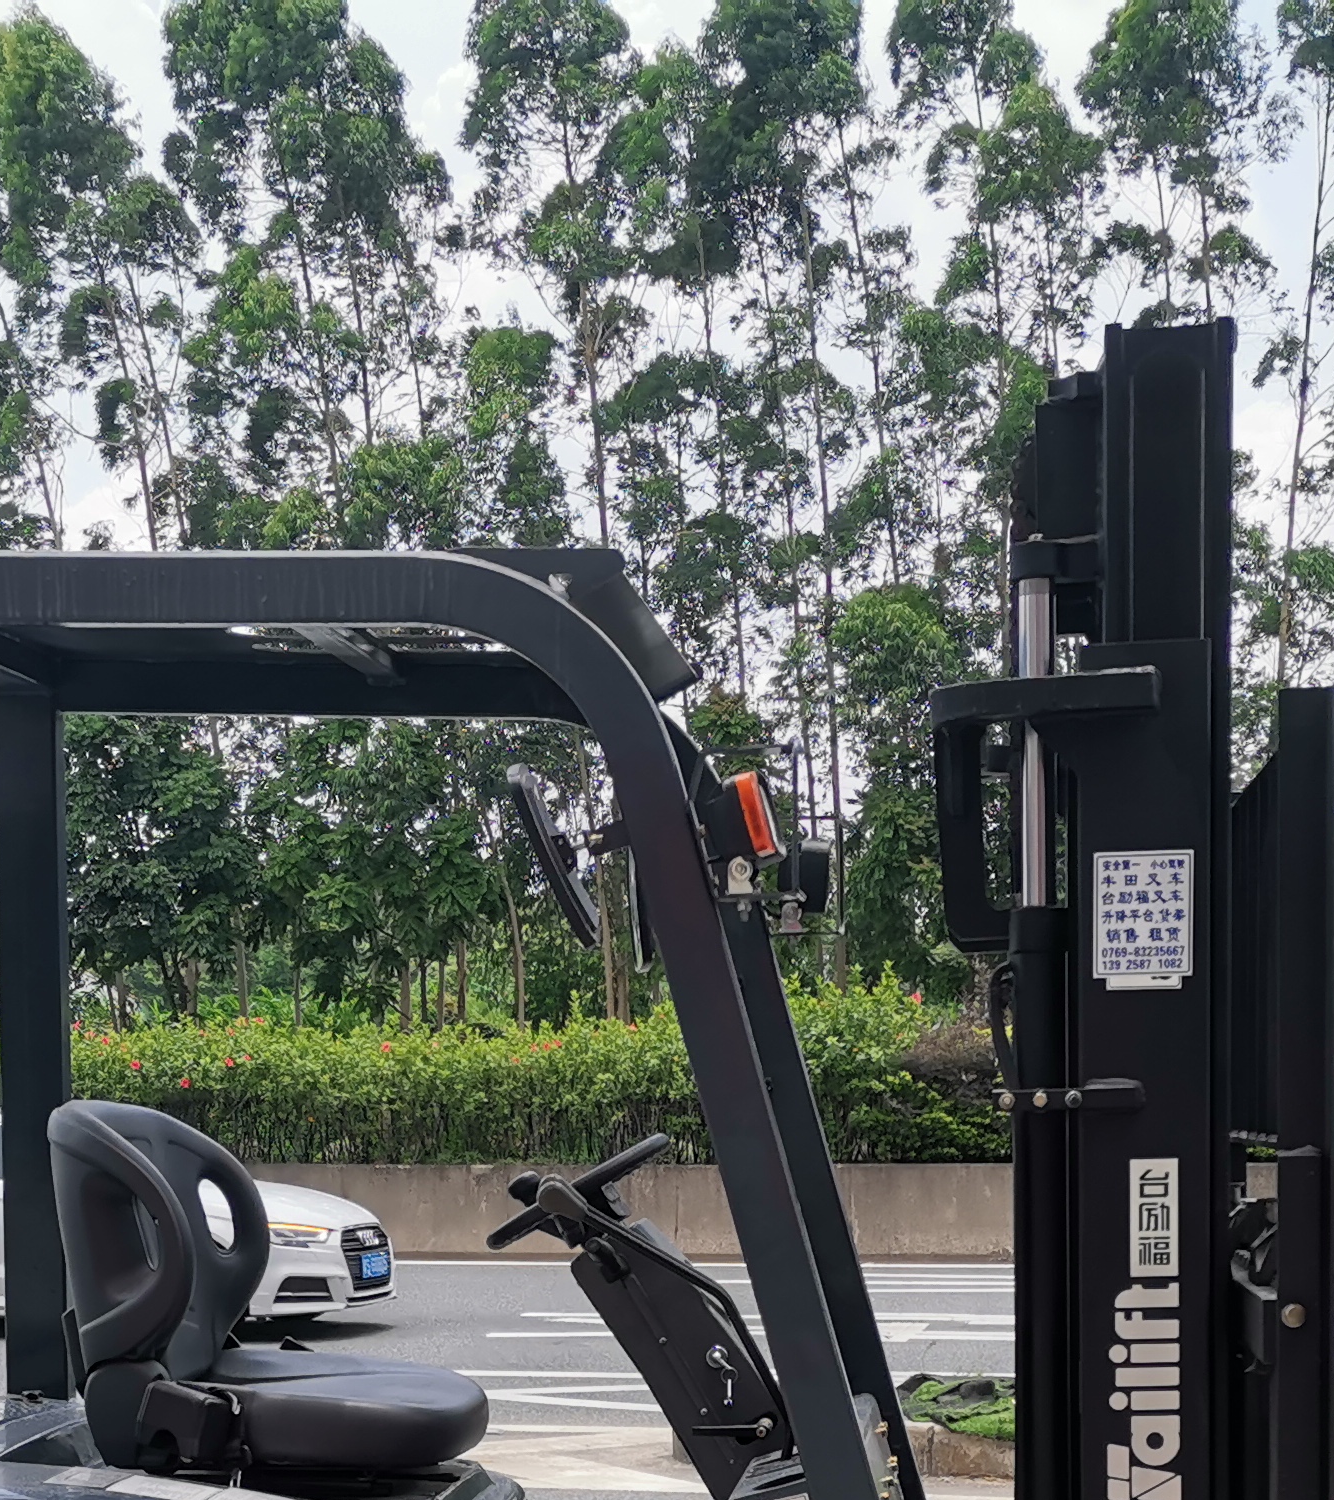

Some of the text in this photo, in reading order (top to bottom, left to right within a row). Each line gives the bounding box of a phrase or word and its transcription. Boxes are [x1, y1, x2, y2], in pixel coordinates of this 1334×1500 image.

[1102, 859, 1141, 871] 安全第一
[1101, 890, 1184, 905] 台励福叉车
[1106, 927, 1181, 944] 销售 租赁
[1101, 945, 1185, 958] 0769-83235667
[1102, 958, 1183, 970] 139 2587 1082
[1138, 1168, 1171, 1266] 台励福
